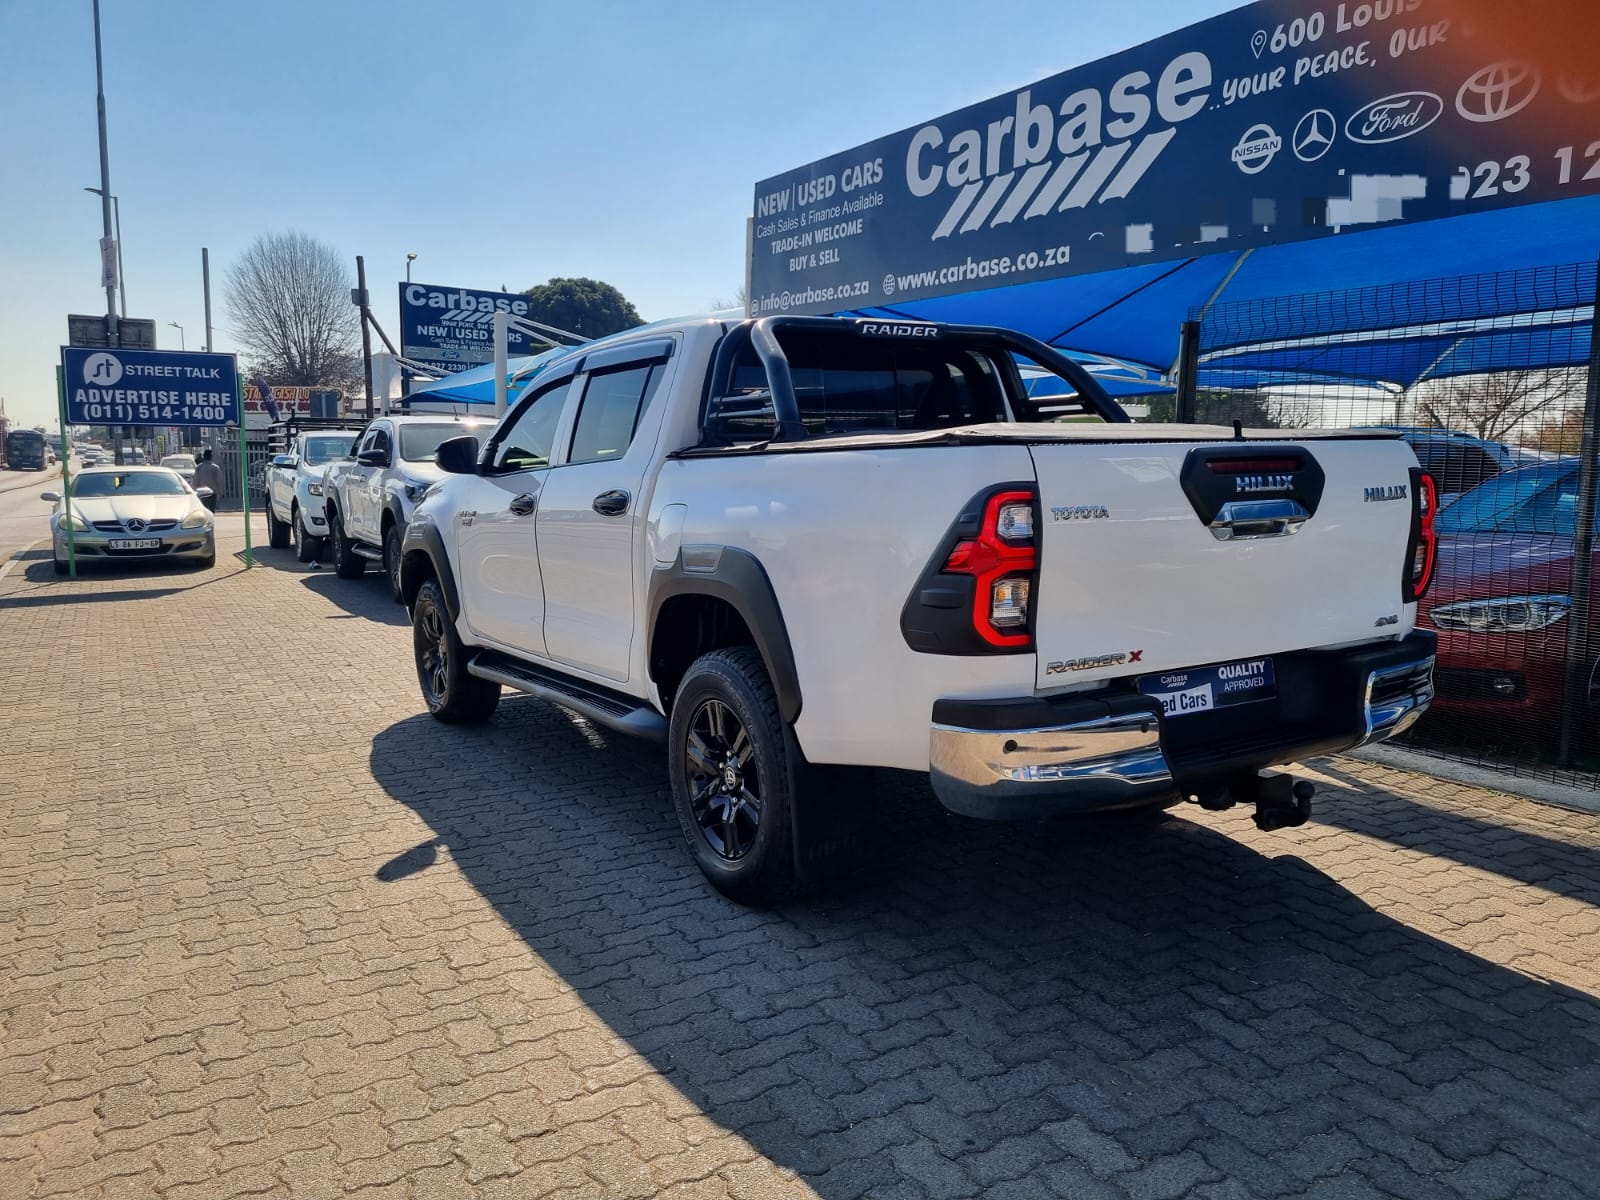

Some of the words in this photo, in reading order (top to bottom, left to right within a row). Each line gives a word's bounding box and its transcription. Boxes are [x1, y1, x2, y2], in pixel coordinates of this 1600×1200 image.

[1270, 12, 1325, 54] 600
[1389, 19, 1452, 58] OUR
[906, 51, 1212, 197] Carbase
[1361, 100, 1425, 136] Ford
[1234, 140, 1279, 158] NISSAN
[757, 189, 790, 218] NEW
[798, 174, 836, 206] USED
[842, 158, 883, 192] CARS
[757, 217, 776, 239] Cash
[777, 214, 799, 236] Sales
[800, 212, 807, 227] &
[808, 202, 841, 224] Finance
[842, 191, 884, 215] Available
[771, 231, 812, 255] TRADE-IN
[814, 219, 863, 246] WELCOME
[789, 255, 808, 273] BUY
[809, 254, 817, 268] &
[819, 247, 840, 266] SELL
[897, 245, 1071, 291] www.carbase.co.za
[405, 286, 529, 315] Carbase
[760, 278, 870, 312] info@carbase.co.za
[417, 325, 448, 337] NEW
[456, 329, 488, 340] USED
[862, 324, 938, 337] RAIDER
[125, 365, 182, 378] STREET
[184, 367, 220, 379] TALK
[75, 389, 180, 405] ADVERTISE
[186, 392, 231, 406] HERE
[83, 404, 133, 421] (011)
[139, 406, 225, 420] 514-1400
[1235, 474, 1294, 493] HILUX
[1364, 485, 1407, 502] HILUX
[1051, 505, 1110, 521] TOYOTA
[1046, 653, 1125, 675] RAIDER
[1128, 650, 1143, 664] X
[1218, 661, 1265, 680] QUALITY
[1160, 674, 1188, 684] Carbase
[1224, 677, 1264, 692] APPROVED
[1180, 693, 1207, 710] Cars
